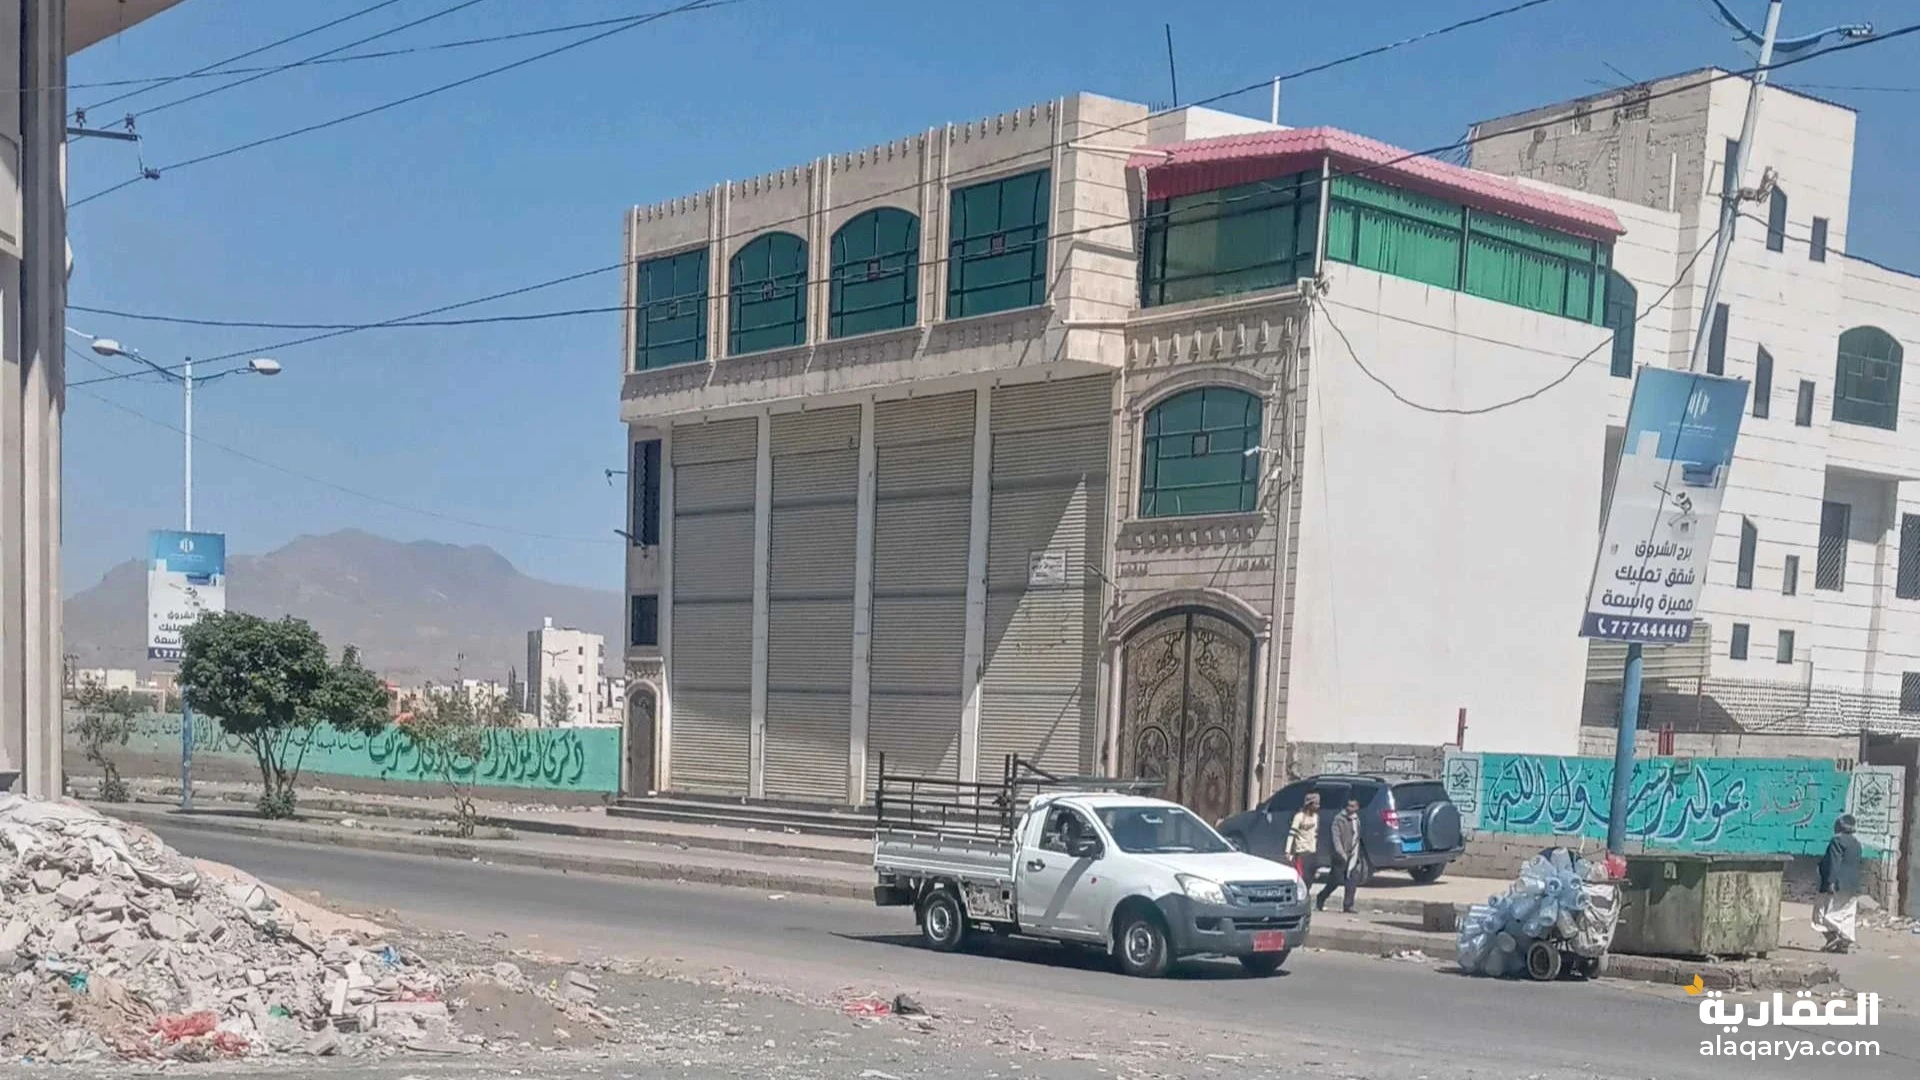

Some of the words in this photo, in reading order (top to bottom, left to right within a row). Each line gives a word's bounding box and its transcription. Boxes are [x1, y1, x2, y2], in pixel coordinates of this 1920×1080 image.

[1635, 540, 1677, 558] الشروق
[1676, 543, 1692, 561] برج
[1615, 565, 1662, 585] تمليك
[1664, 567, 1695, 587] شقق
[1602, 589, 1655, 614] واسعة
[1658, 594, 1693, 615] مميزة
[158, 623, 182, 633] مليك
[1611, 620, 1687, 637] 777444449
[154, 635, 181, 645] اسعة
